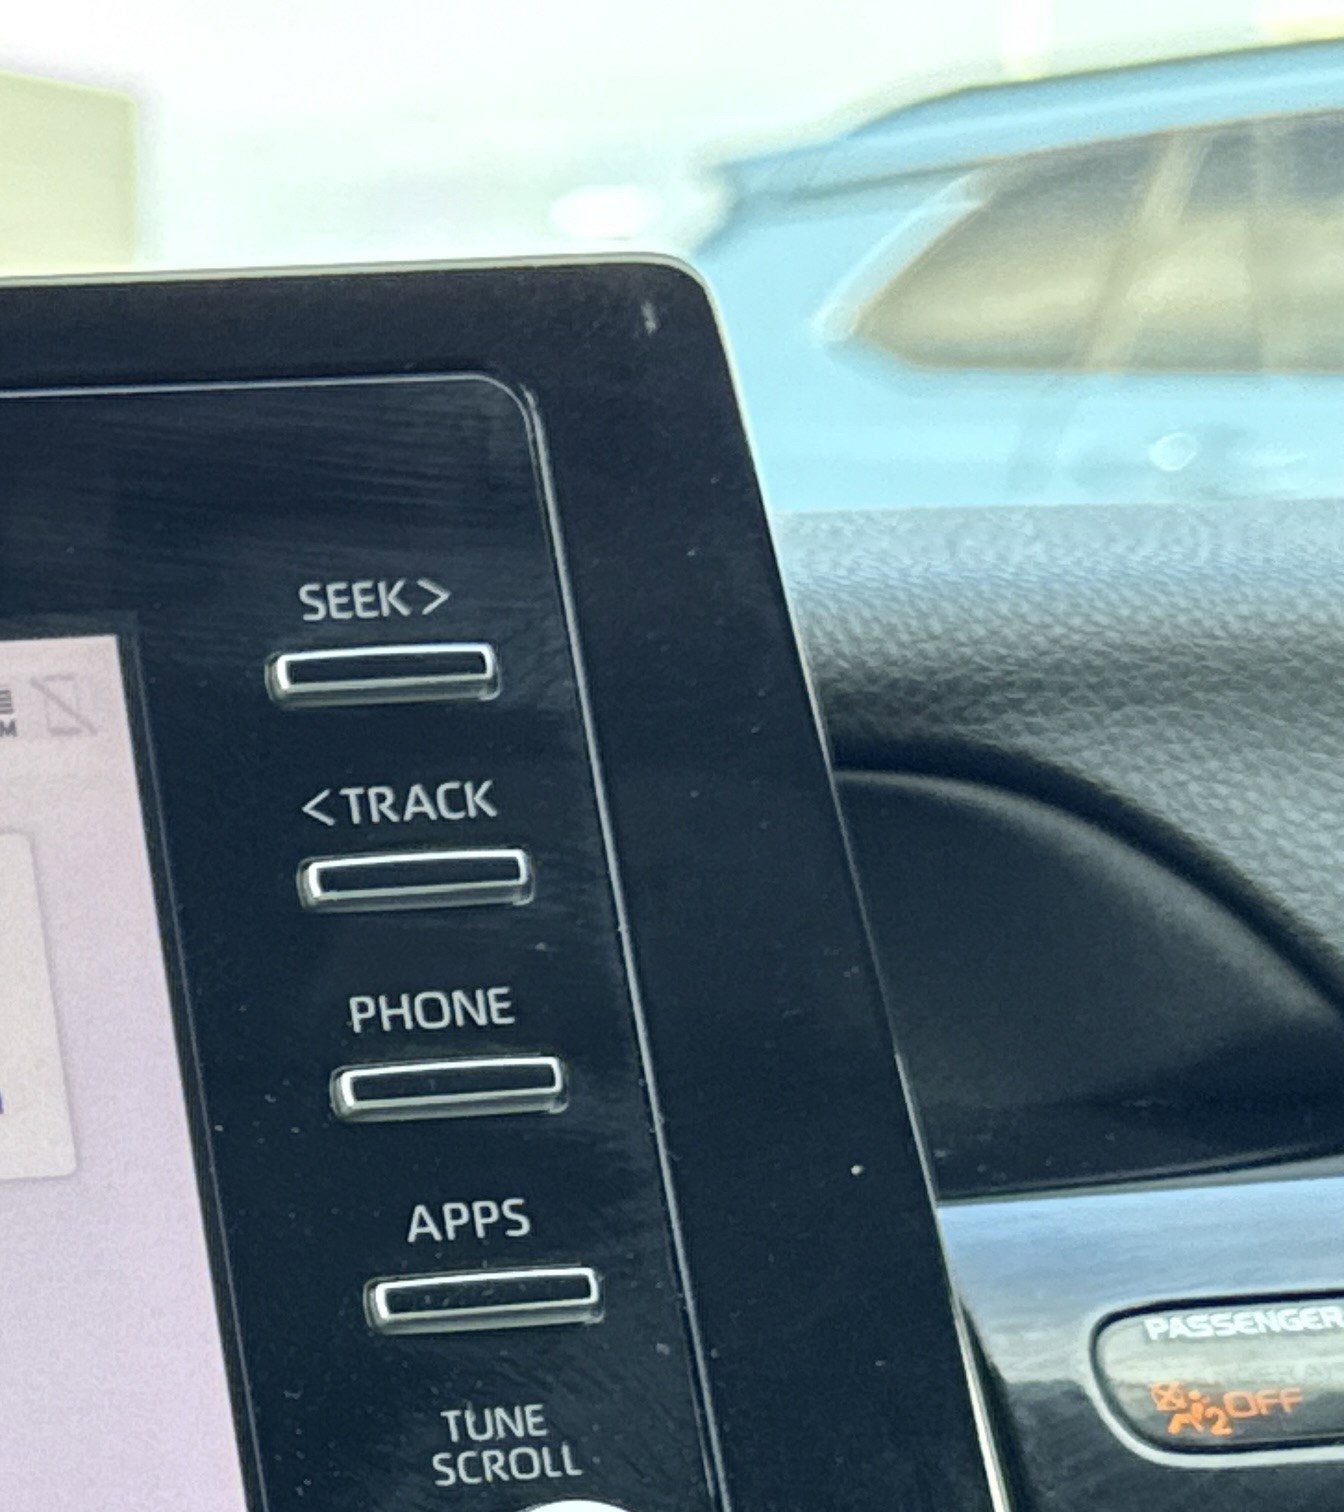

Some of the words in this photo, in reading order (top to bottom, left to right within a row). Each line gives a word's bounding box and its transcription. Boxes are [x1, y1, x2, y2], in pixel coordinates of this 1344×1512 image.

[349, 987, 515, 1034] PHONE
[407, 1198, 531, 1243] APPS
[1144, 1305, 1344, 1340] PASSENGER
[1223, 1387, 1303, 1418] OFF
[441, 1404, 548, 1443] TUNE
[432, 1442, 583, 1486] SCROLL
